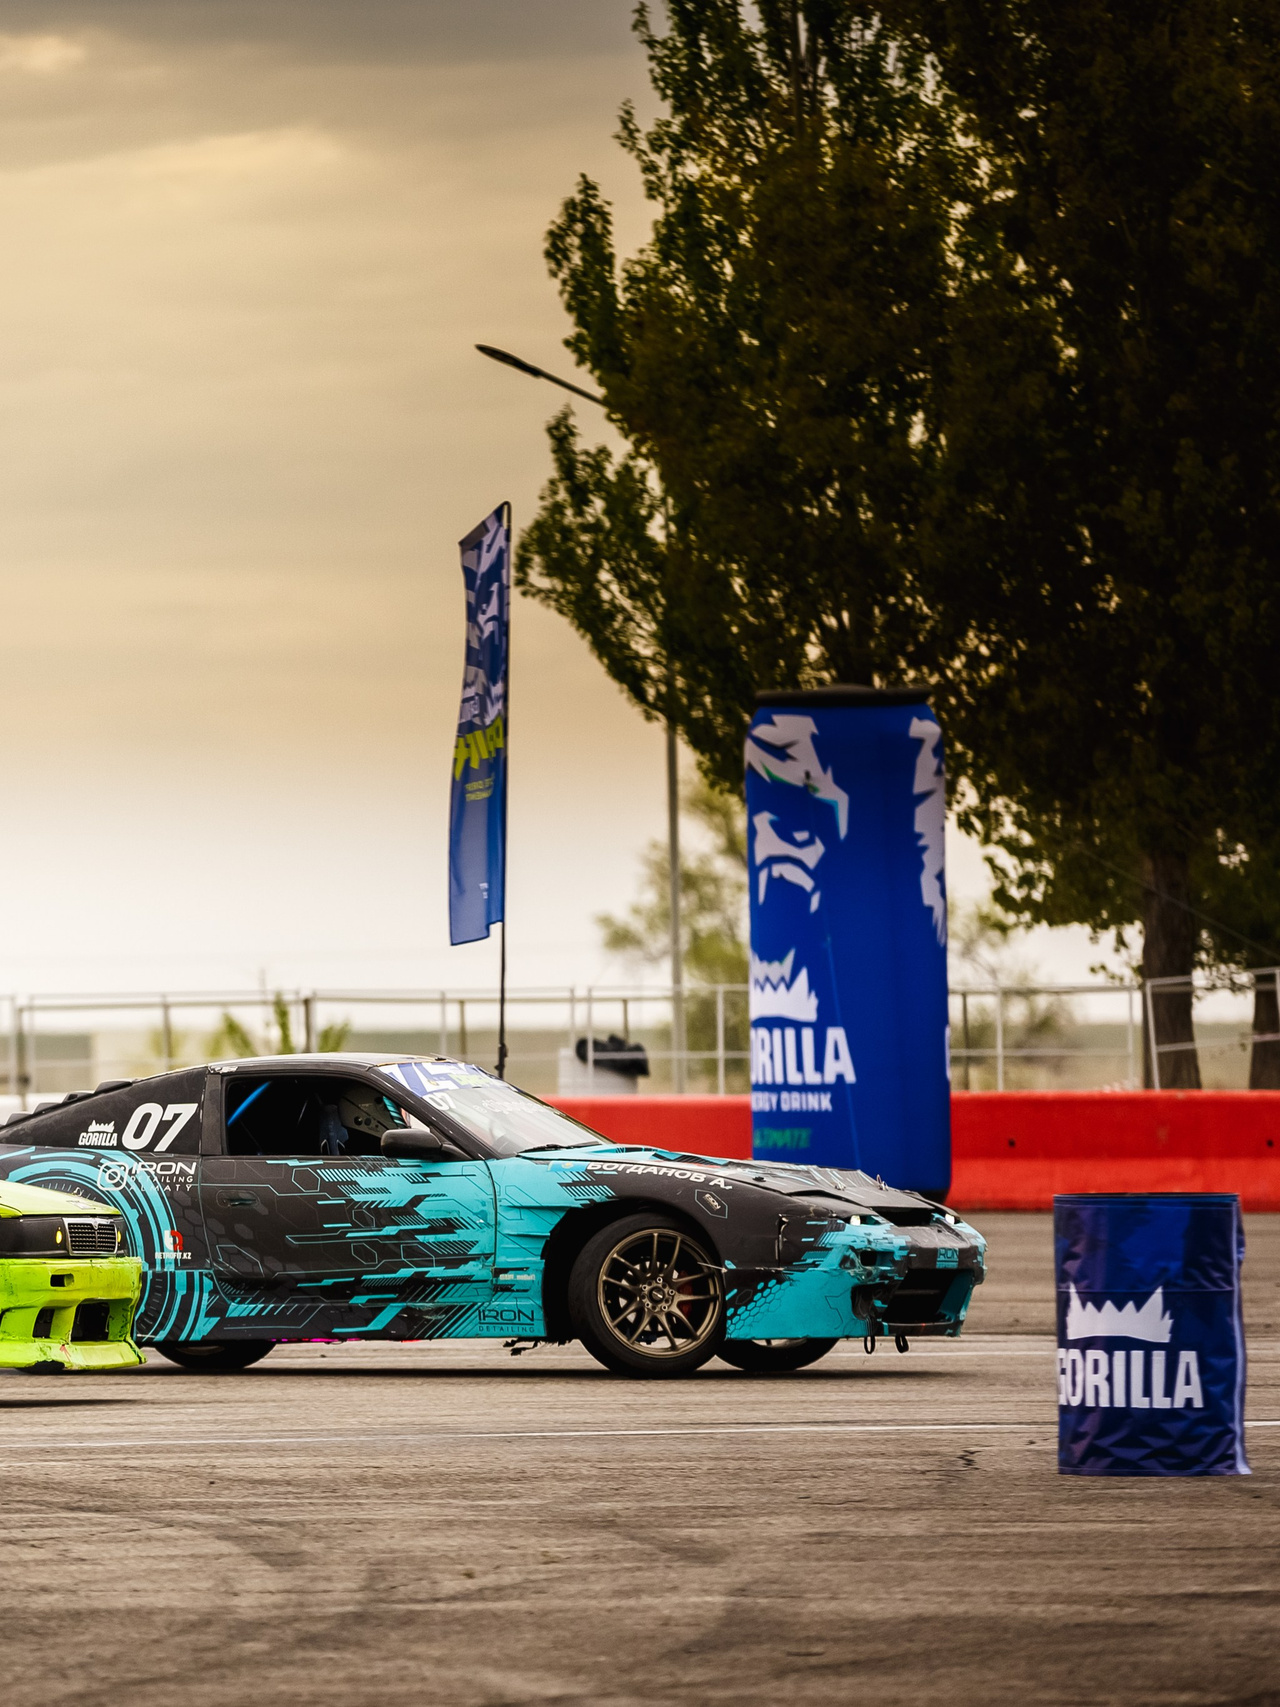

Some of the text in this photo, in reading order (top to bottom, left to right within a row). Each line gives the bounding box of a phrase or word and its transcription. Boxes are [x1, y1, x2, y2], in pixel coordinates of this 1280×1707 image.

[422, 1092, 456, 1111] 07
[780, 1091, 833, 1112] DRINK
[122, 1102, 198, 1152] 07
[78, 1133, 118, 1146] GORILLA
[131, 1162, 196, 1174] IRON
[587, 1162, 706, 1183] БОГДАНОВ
[478, 1309, 535, 1322] IRON
